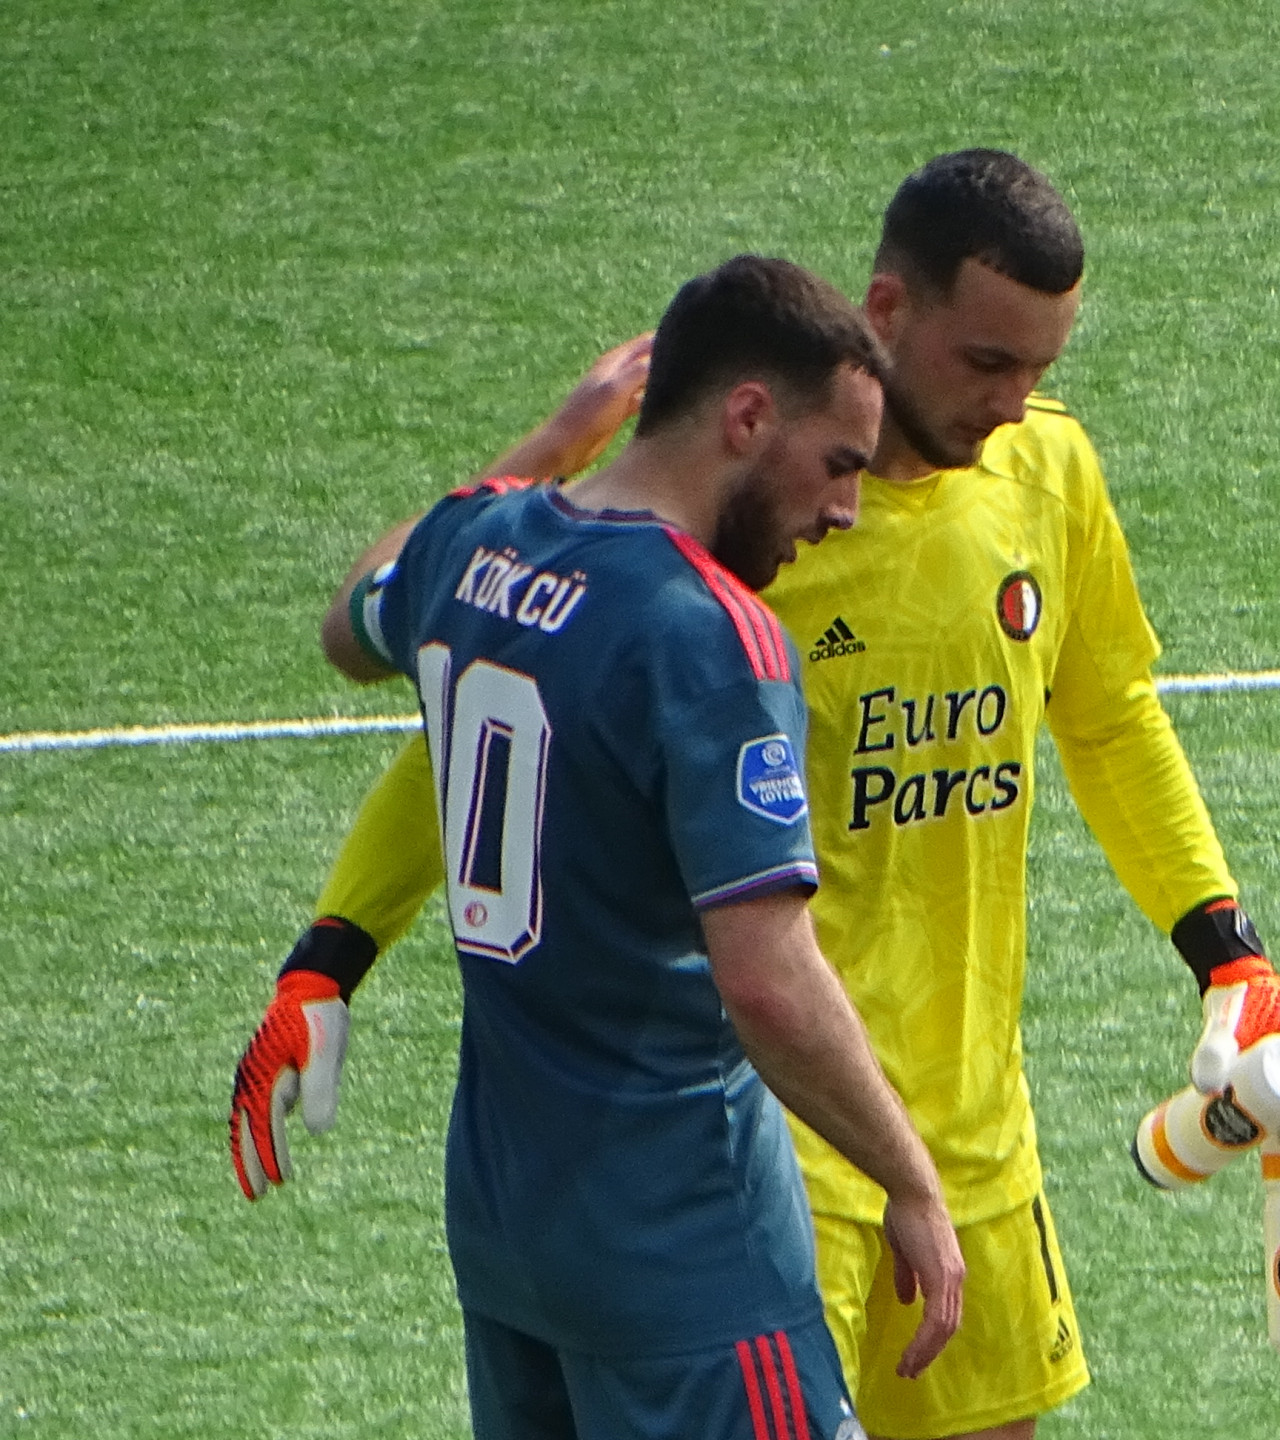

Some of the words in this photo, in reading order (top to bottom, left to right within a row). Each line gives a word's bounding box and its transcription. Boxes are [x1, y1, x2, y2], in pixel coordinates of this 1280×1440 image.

[809, 640, 867, 663] adidas
[853, 684, 1007, 756] Euro
[417, 641, 552, 964] 10
[848, 761, 1022, 832] Parcs
